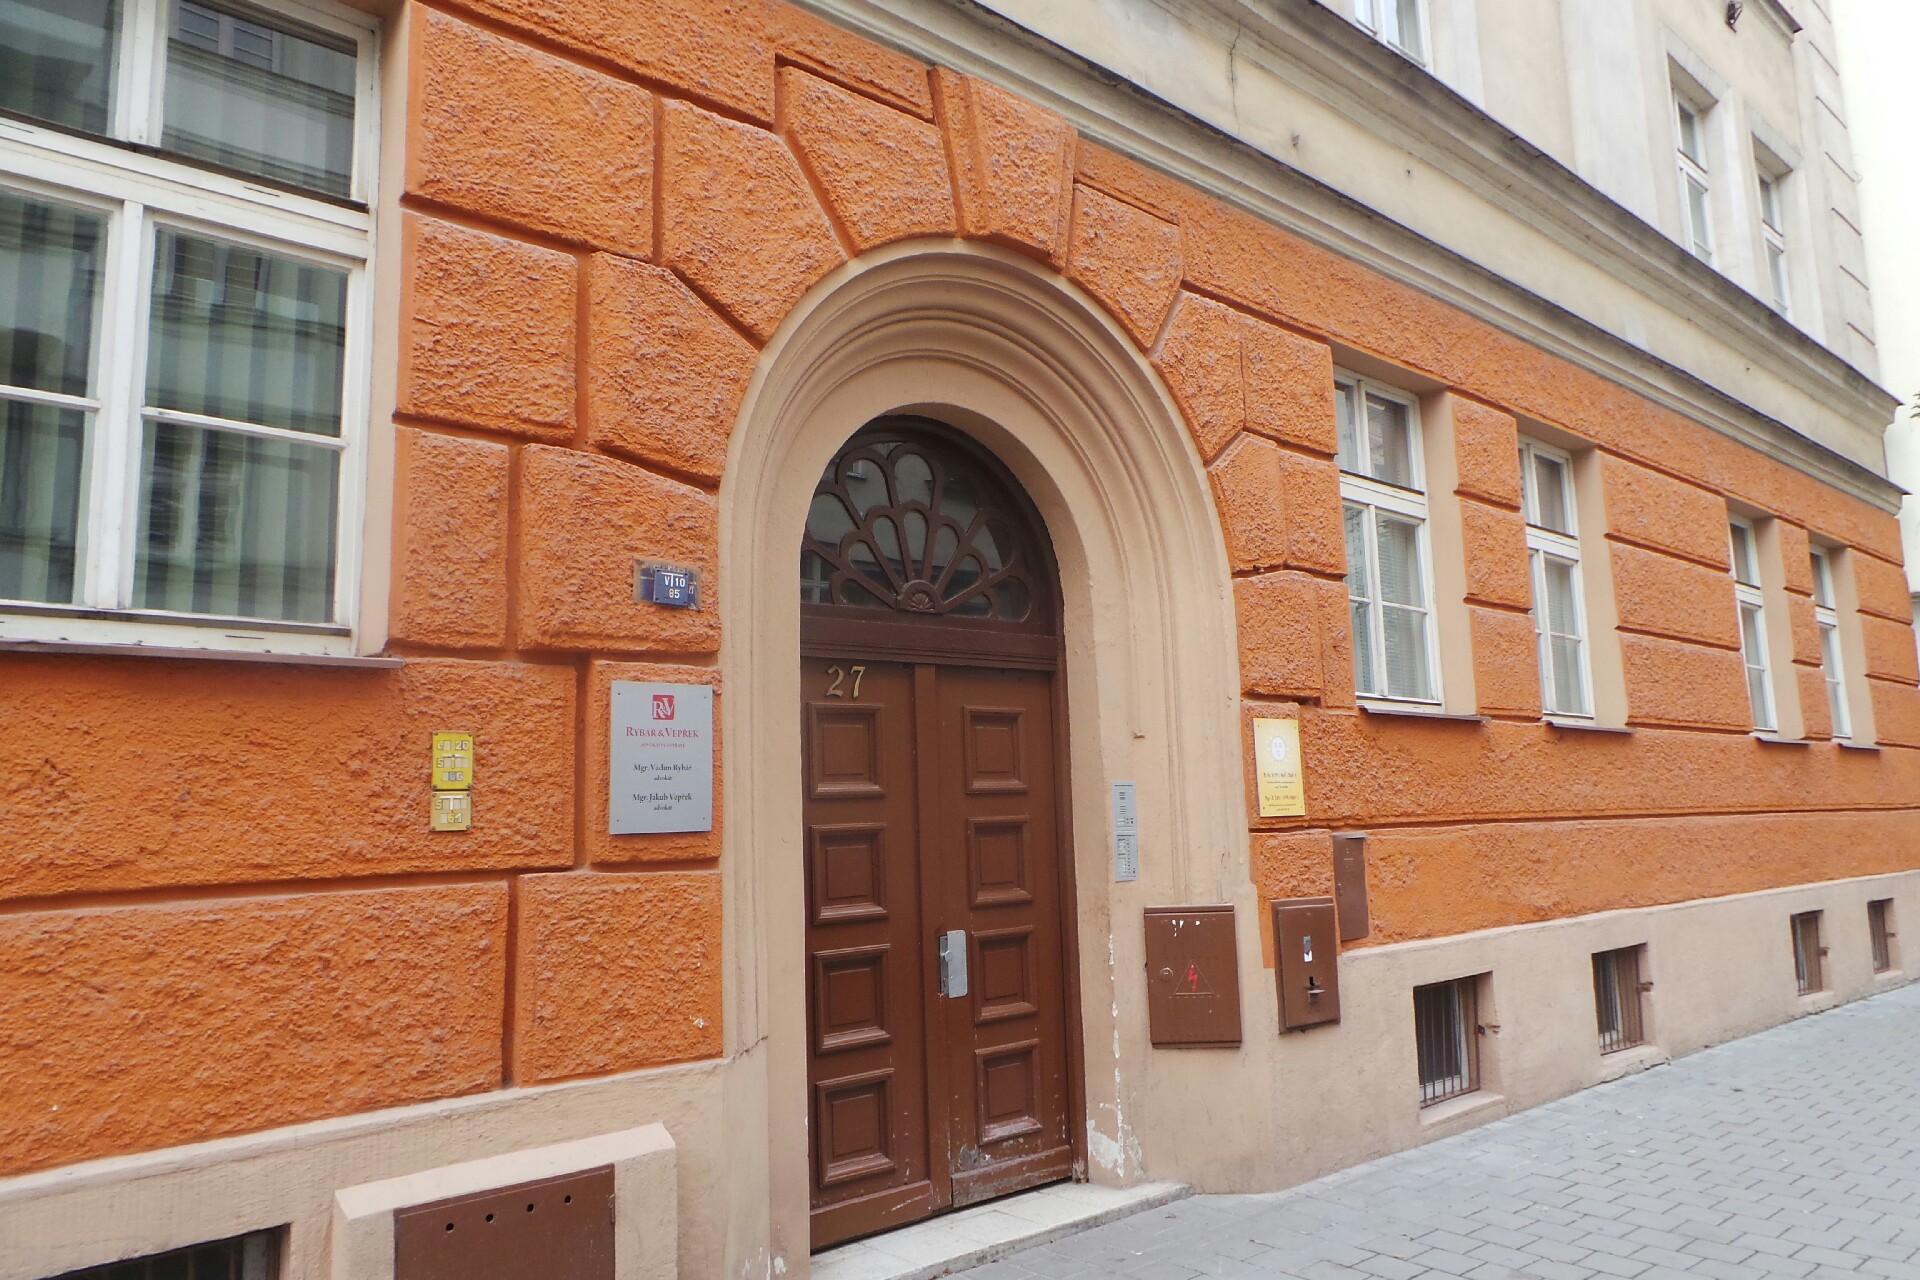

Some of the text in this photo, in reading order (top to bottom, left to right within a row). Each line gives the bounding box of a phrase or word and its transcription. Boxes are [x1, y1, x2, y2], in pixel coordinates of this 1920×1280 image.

[668, 588, 680, 599] 85
[825, 664, 866, 698] 27
[657, 729, 664, 738] &
[633, 764, 649, 773] Mgr.
[650, 763, 672, 771] Vadim
[632, 793, 648, 803] Mgr.
[648, 792, 668, 803] Jakub
